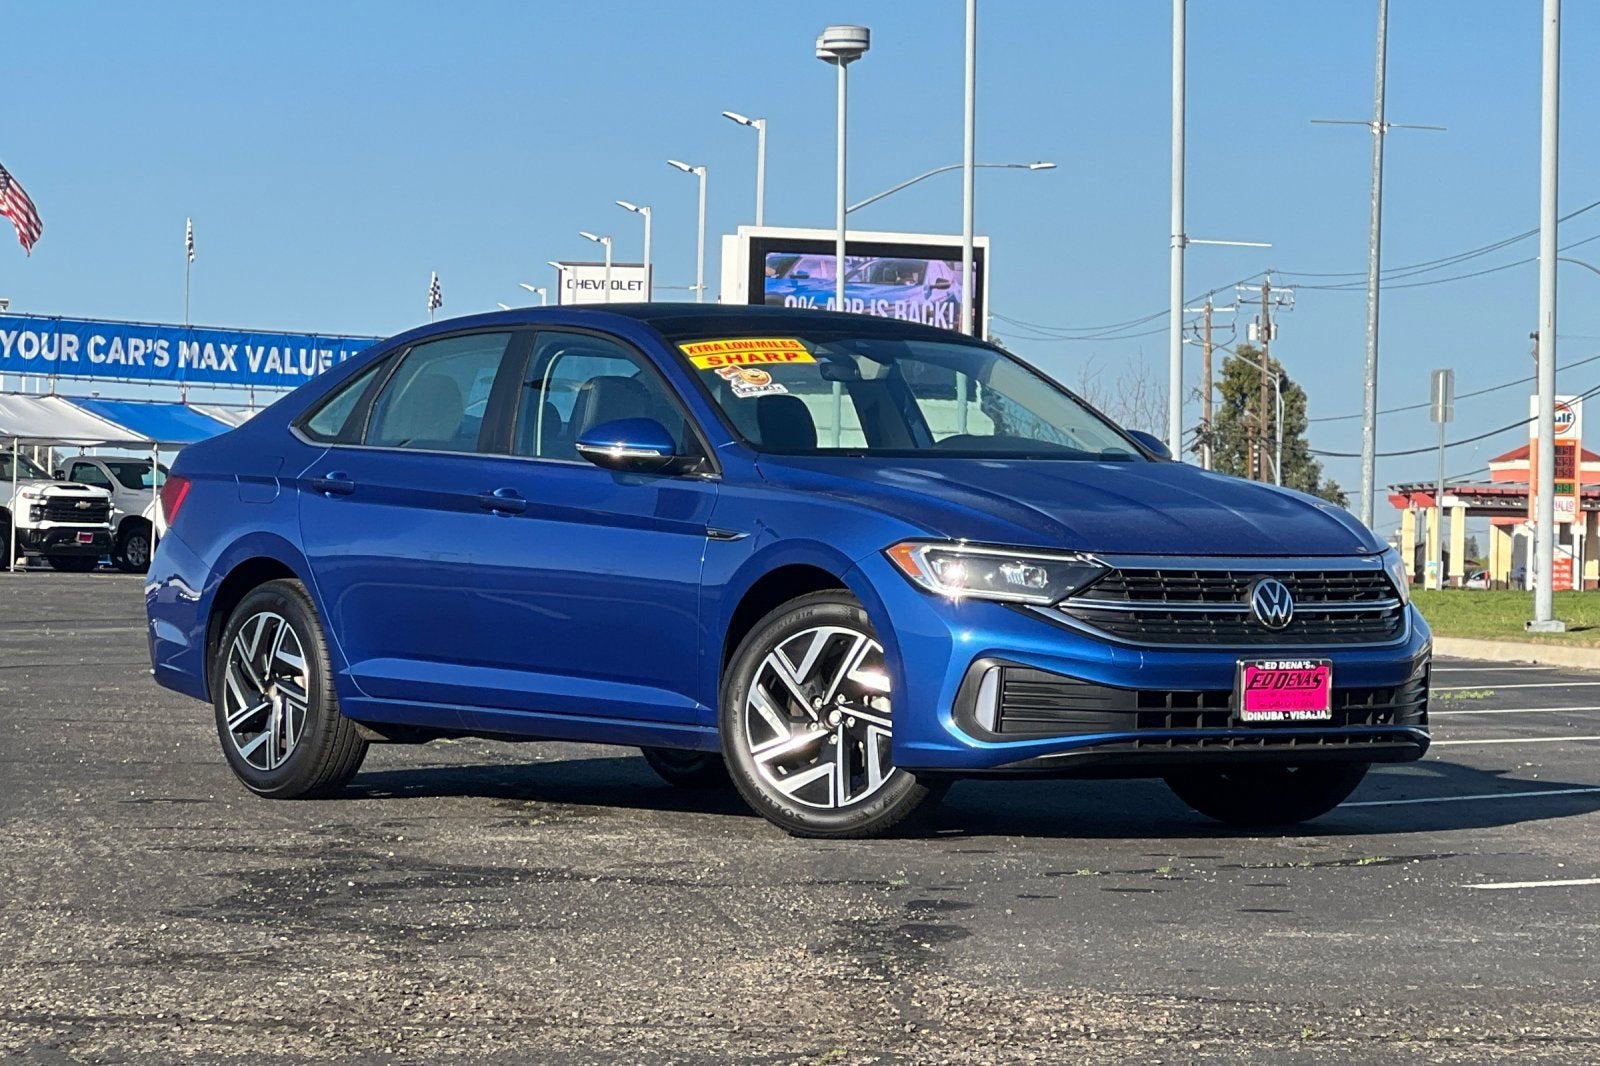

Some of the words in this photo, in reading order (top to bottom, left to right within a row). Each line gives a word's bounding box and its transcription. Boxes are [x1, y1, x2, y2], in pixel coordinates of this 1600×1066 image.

[894, 300, 954, 329] BACK!
[0, 330, 79, 362] YOUR
[87, 335, 170, 368] CAR'S
[178, 341, 238, 372] MAX
[246, 345, 332, 376] VALUE
[688, 343, 724, 354] XTRA
[725, 340, 754, 351] LOW
[756, 338, 799, 349] MILES
[706, 352, 798, 366] SHARP
[1554, 412, 1572, 423] ulf
[1264, 661, 1277, 670] ED
[1279, 660, 1311, 670] DENA'S
[1246, 672, 1275, 690] ED
[1247, 711, 1285, 720] DINUBA
[1289, 710, 1327, 720] VISALIA
